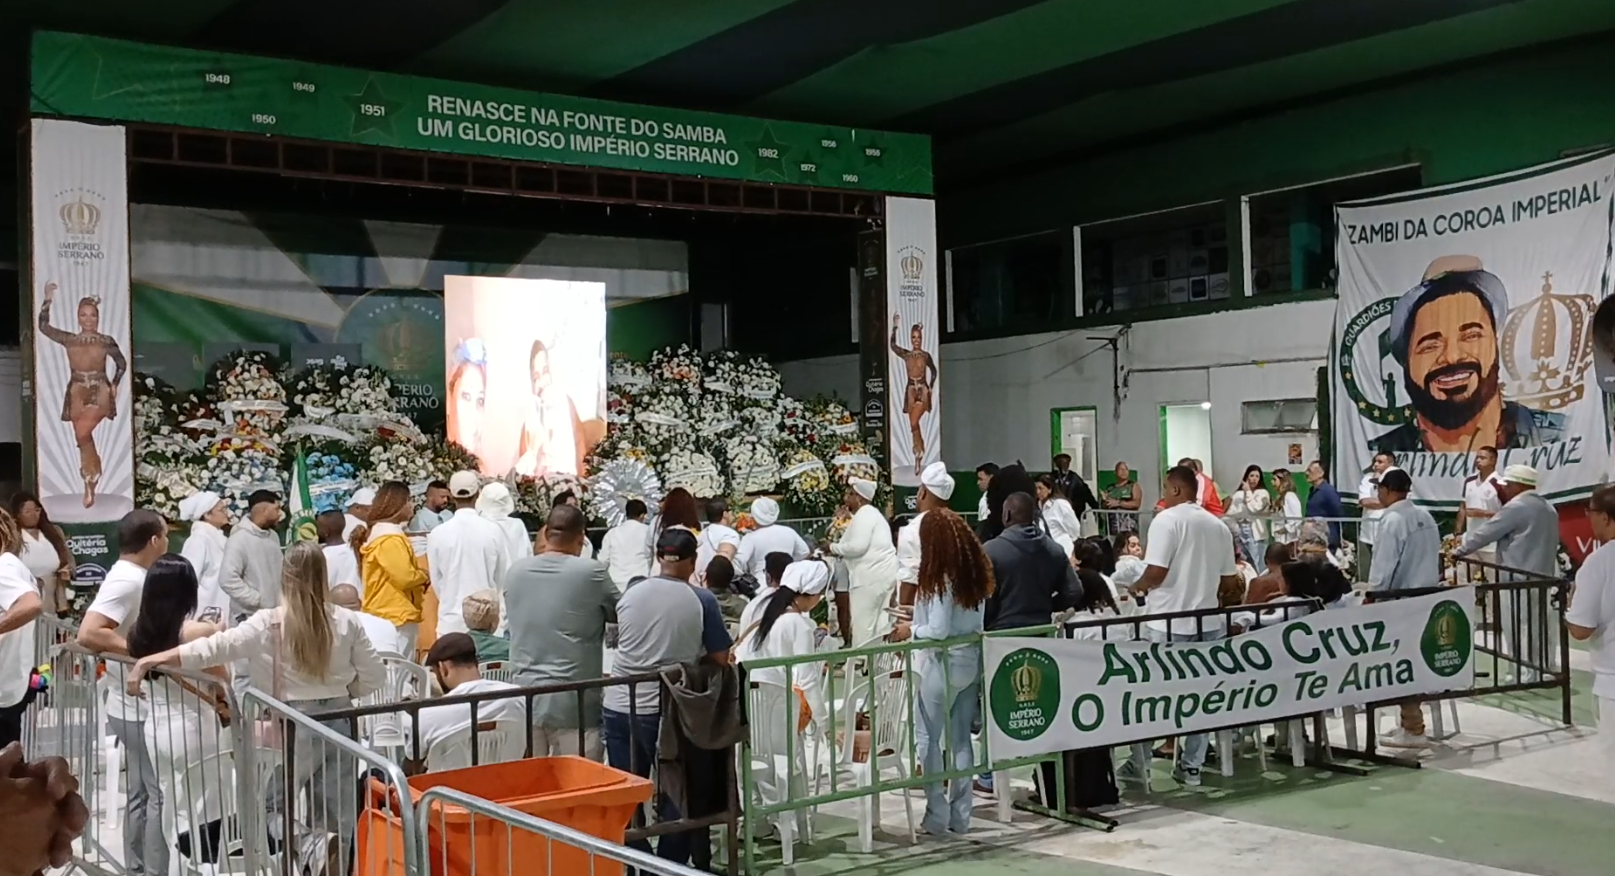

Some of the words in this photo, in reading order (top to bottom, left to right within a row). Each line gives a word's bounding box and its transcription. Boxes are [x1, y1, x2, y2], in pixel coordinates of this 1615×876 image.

[205, 73, 231, 85] 1948
[292, 82, 316, 93] 1949
[360, 103, 386, 117] 1951
[251, 114, 277, 125] 1950
[427, 94, 527, 123] RENASCE
[530, 106, 561, 127] NA
[562, 111, 627, 135] FONTE
[630, 118, 659, 137] DO
[662, 122, 727, 145] SAMBA
[417, 116, 454, 138] UM
[457, 121, 566, 150] GLORIOSO
[569, 133, 650, 158] IMPÉRIO
[653, 142, 739, 167] SERRANO
[758, 147, 779, 159] 1982
[800, 163, 816, 172] 1972
[1403, 217, 1428, 240] DA
[1432, 204, 1506, 236] COROA
[58, 250, 105, 260] SERRANO
[1345, 301, 1392, 347] GUARDIÕES
[72, 546, 109, 557] Chagas
[1097, 638, 1273, 686] Arlindo
[1282, 620, 1400, 665] Cruz,
[1072, 693, 1105, 732] O
[1121, 679, 1279, 729] Império
[1294, 671, 1328, 701] Te
[1338, 658, 1415, 695] Ama
[1010, 707, 1042, 720] IMPÉRIO
[1008, 717, 1045, 729] SERRANO
